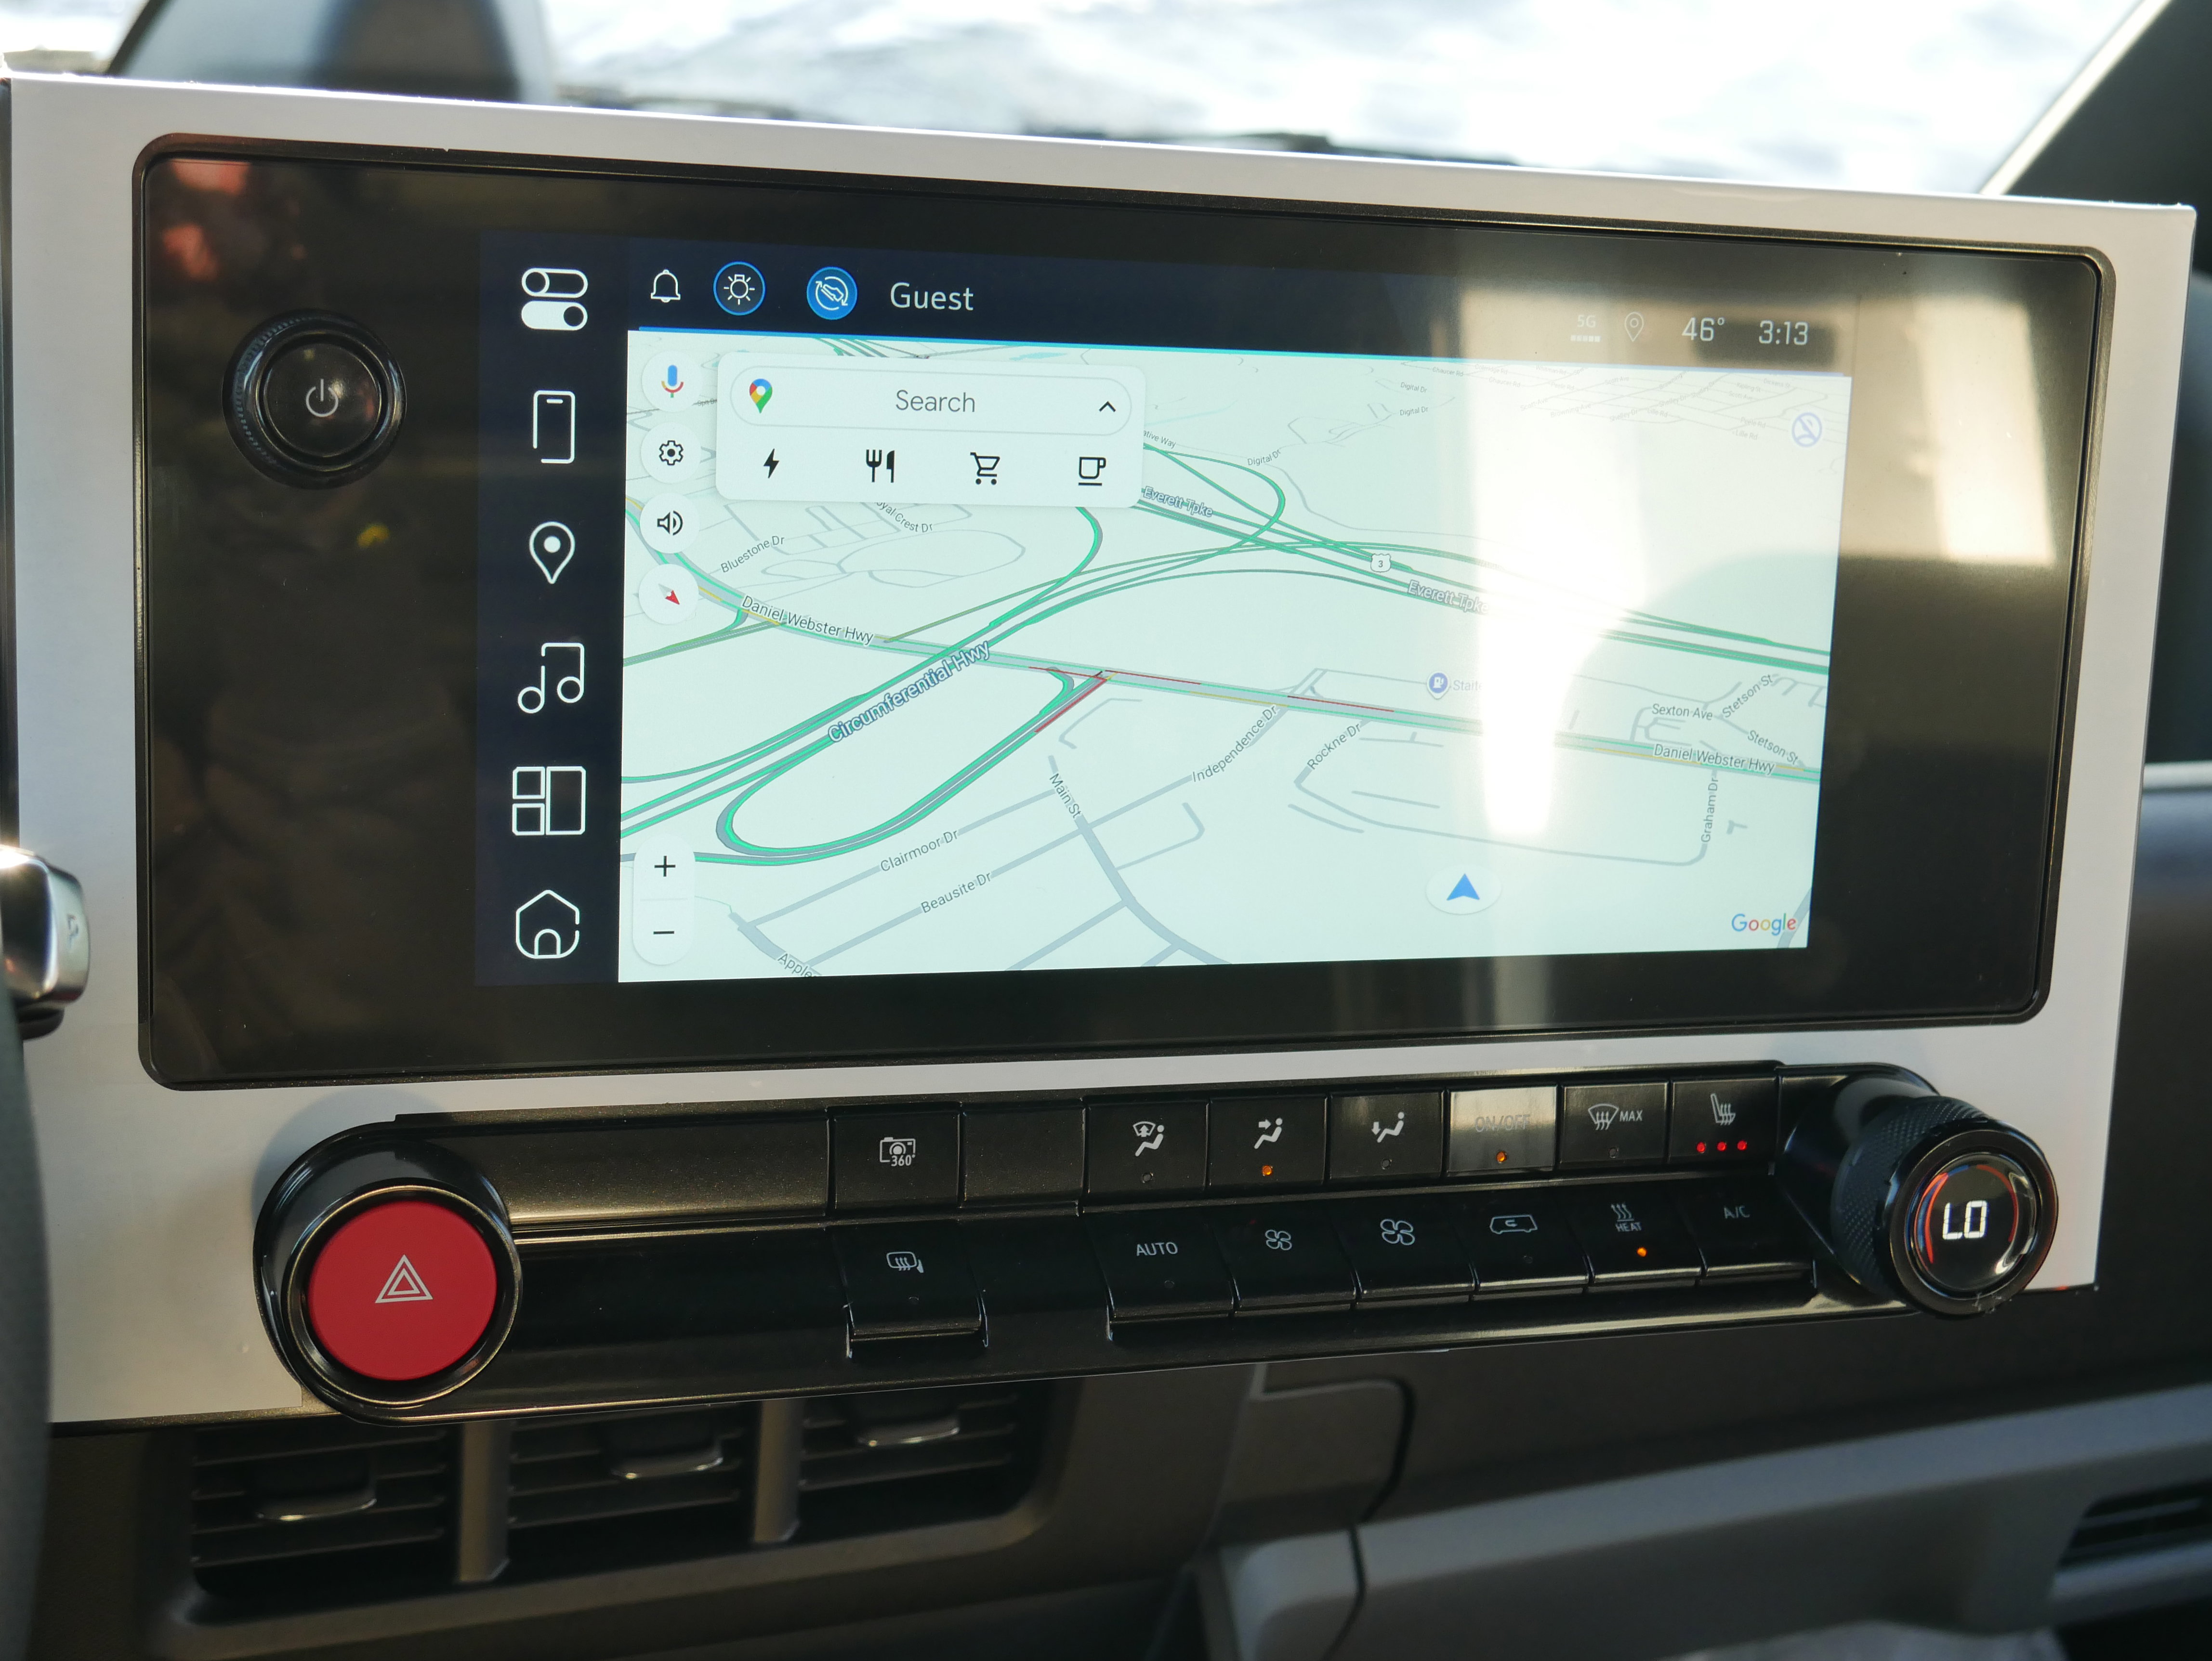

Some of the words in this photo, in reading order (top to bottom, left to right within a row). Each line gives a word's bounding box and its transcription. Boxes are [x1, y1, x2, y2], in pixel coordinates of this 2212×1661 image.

[890, 282, 974, 311] Guest
[1577, 315, 1596, 328] 5G
[1758, 319, 1809, 346] 3:13
[1400, 382, 1420, 391] Digital
[895, 389, 976, 413] Search
[1400, 407, 1420, 416] Digital
[1520, 401, 1537, 411] Scott
[1550, 407, 1580, 418] Browning
[1609, 410, 1631, 422] Shelley
[1161, 436, 1176, 449] Way
[1247, 454, 1272, 466] Digital
[1272, 448, 1281, 459] Dr
[1143, 486, 1184, 509] Everett
[1186, 499, 1213, 517] Tpke
[895, 513, 918, 532] Crest
[921, 523, 933, 533] Dr
[721, 540, 770, 573] Bluestone
[772, 535, 785, 546] Dr
[1408, 580, 1455, 605] Everett
[1458, 593, 1489, 613] Tpke
[742, 595, 784, 622] Daniel
[788, 612, 842, 637] Webster
[844, 626, 874, 646] Hwy
[828, 659, 953, 742] Circumferential
[951, 640, 990, 672] Hwy
[1722, 683, 1761, 718] Stetson
[1760, 674, 1773, 687] St
[1652, 703, 1689, 717] Sexton
[1692, 707, 1713, 721] Ave
[1192, 719, 1265, 782] Independence
[1262, 706, 1277, 721] Dr
[1307, 734, 1347, 770] Rockne
[1347, 723, 1360, 738] Dr
[1747, 730, 1786, 756] Stetson
[1786, 751, 1798, 765] St
[1654, 743, 1693, 761] Daniel
[1697, 749, 1746, 769] Webster
[1749, 758, 1775, 776] Hwy
[1049, 773, 1071, 804] Main
[1068, 803, 1081, 818] St
[1708, 777, 1718, 791] Dr
[1701, 795, 1717, 843] Graham
[880, 837, 941, 871] Clairmoor
[943, 830, 958, 844] Dr
[921, 881, 975, 913] Beausite
[976, 872, 991, 886] Dr
[1731, 912, 1796, 936] Google
[777, 953, 815, 977] Apple
[1474, 1114, 1531, 1133] ON/OFF
[1619, 1110, 1644, 1122] MAX
[1723, 1205, 1750, 1219] A/C
[1615, 1222, 1642, 1232] HEAT
[1136, 1241, 1178, 1256] AUTO
